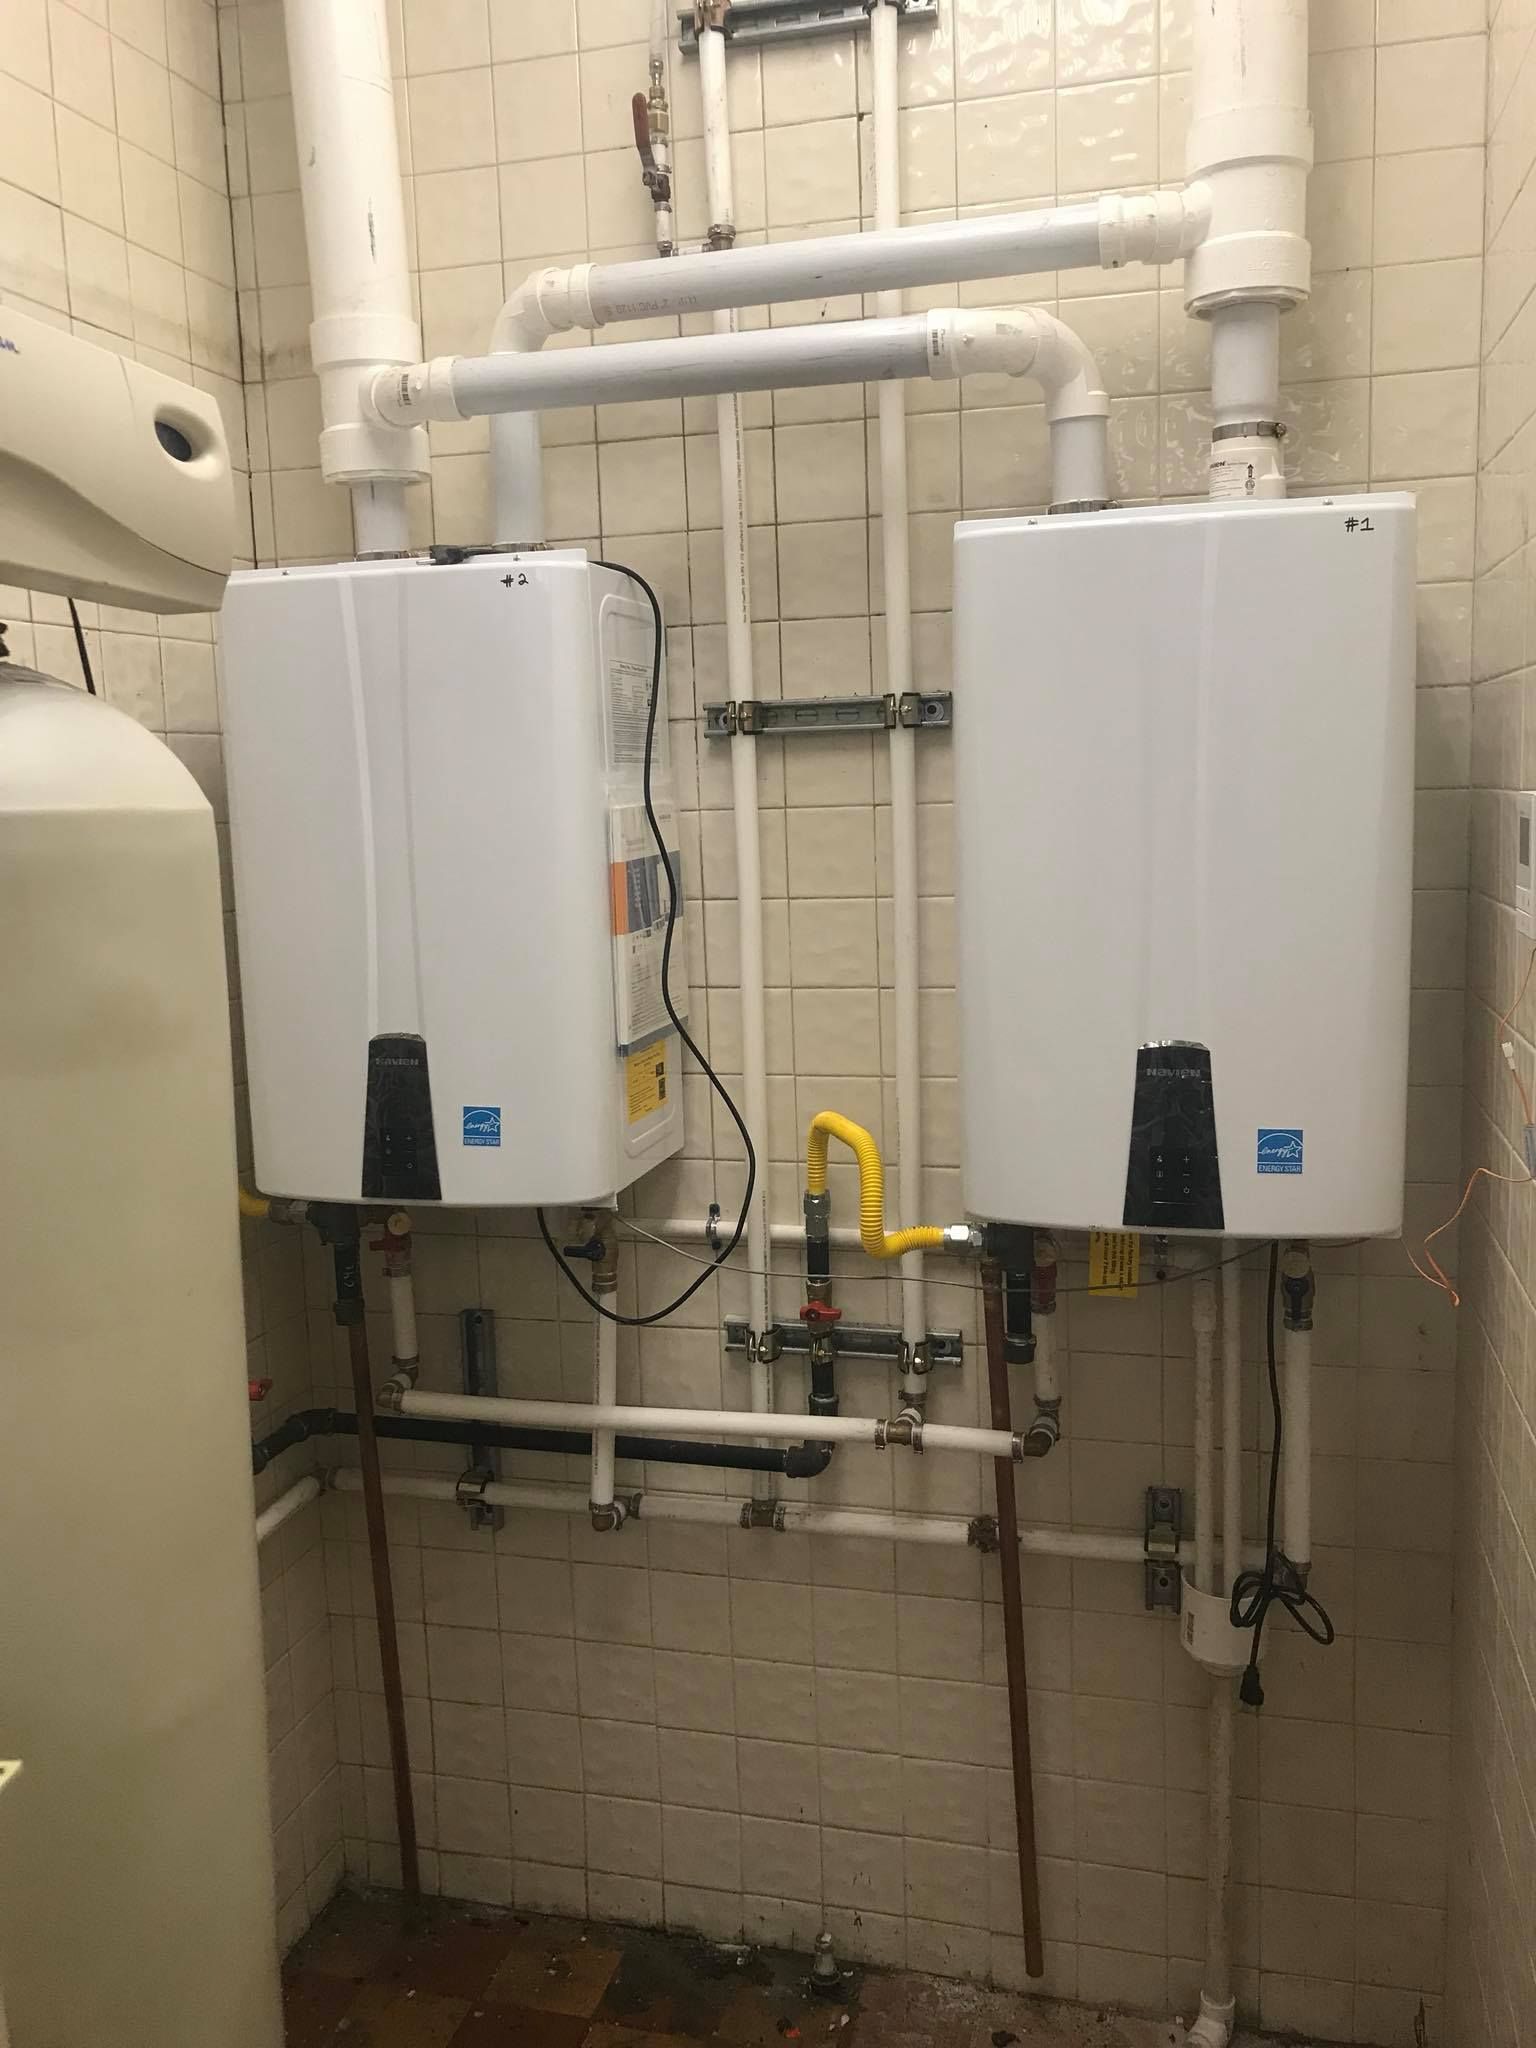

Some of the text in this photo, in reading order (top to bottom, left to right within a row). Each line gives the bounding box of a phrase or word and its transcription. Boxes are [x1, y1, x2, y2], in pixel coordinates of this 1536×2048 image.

[1344, 516, 1375, 533] #1
[500, 572, 529, 588] #2
[1258, 1164, 1301, 1172] ENERGY STAR
